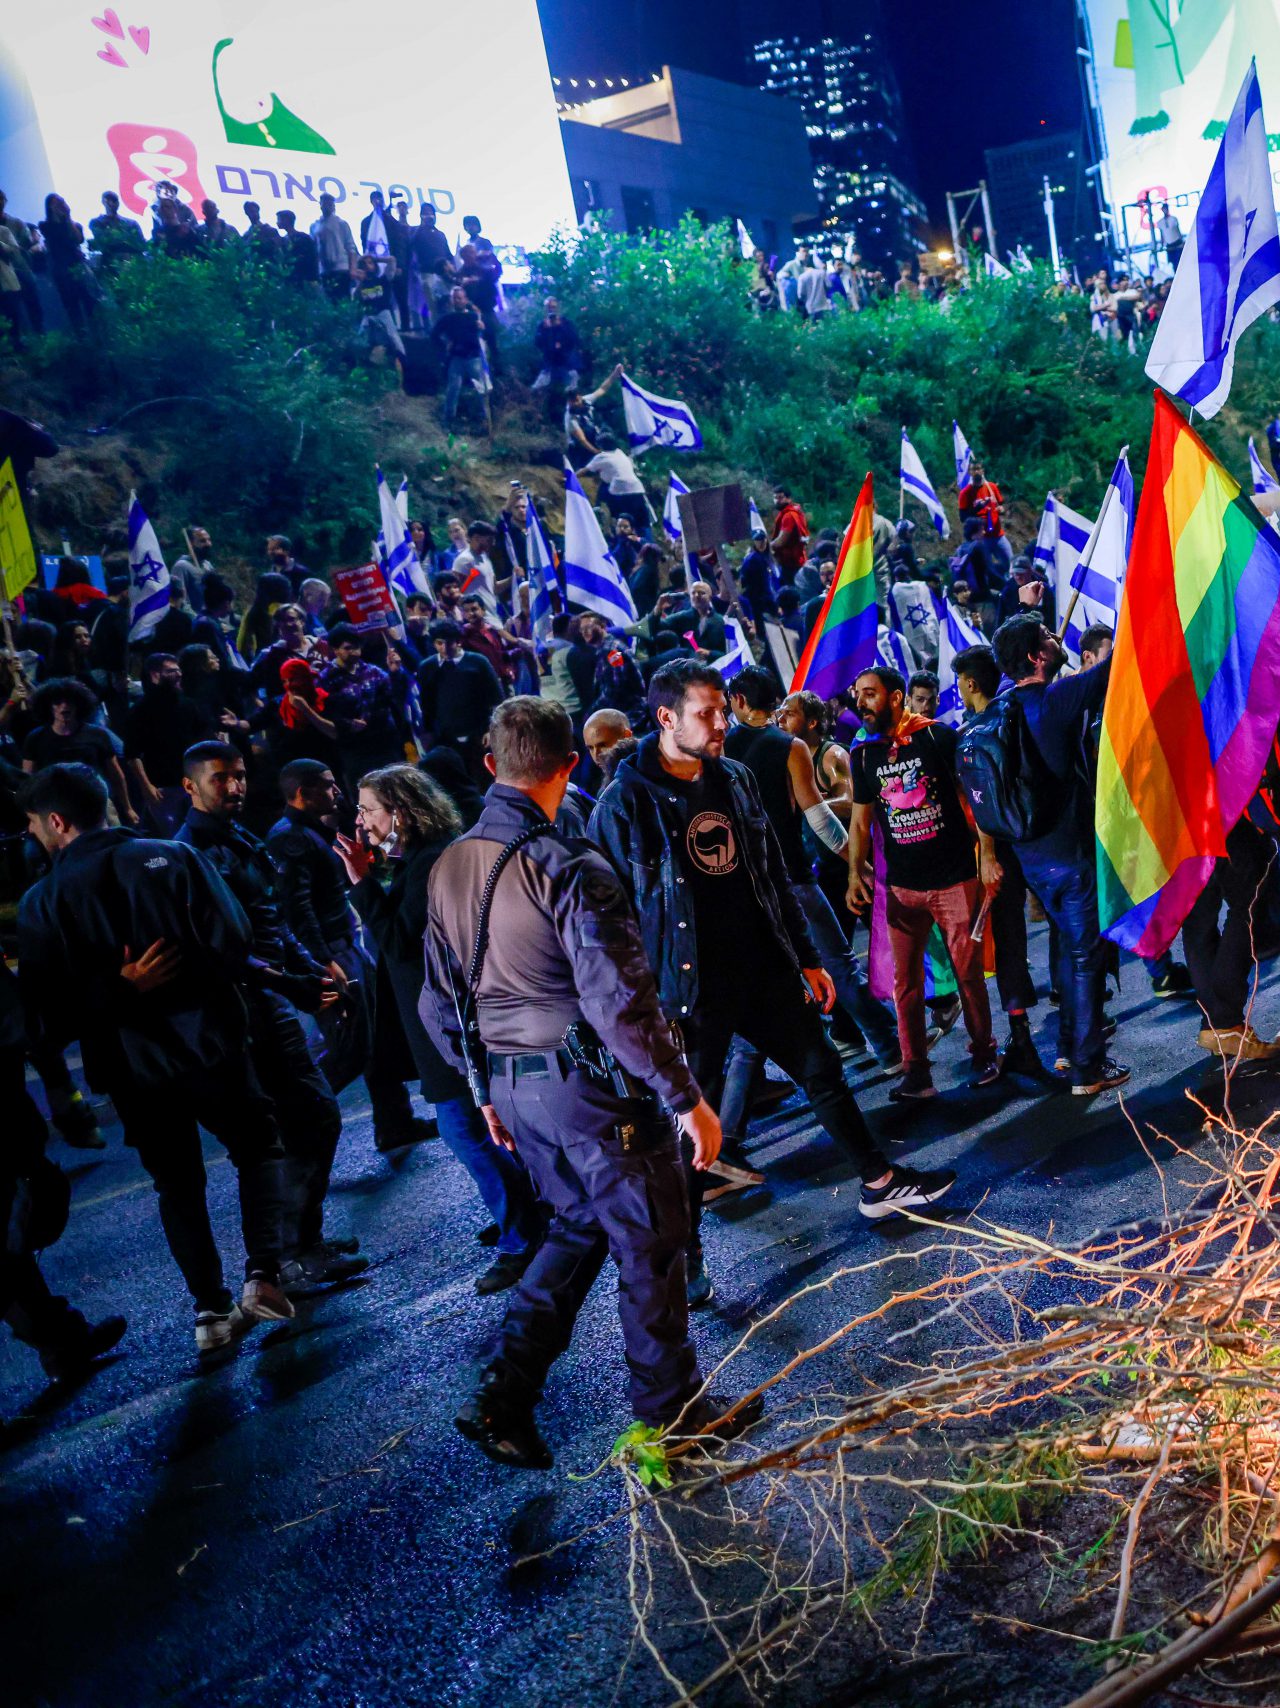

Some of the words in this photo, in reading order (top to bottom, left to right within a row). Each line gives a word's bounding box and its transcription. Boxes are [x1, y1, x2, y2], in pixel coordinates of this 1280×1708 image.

[876, 757, 922, 777] ALWAYS
[895, 804, 942, 822] YOURSELF
[709, 862, 734, 872] AKTION
